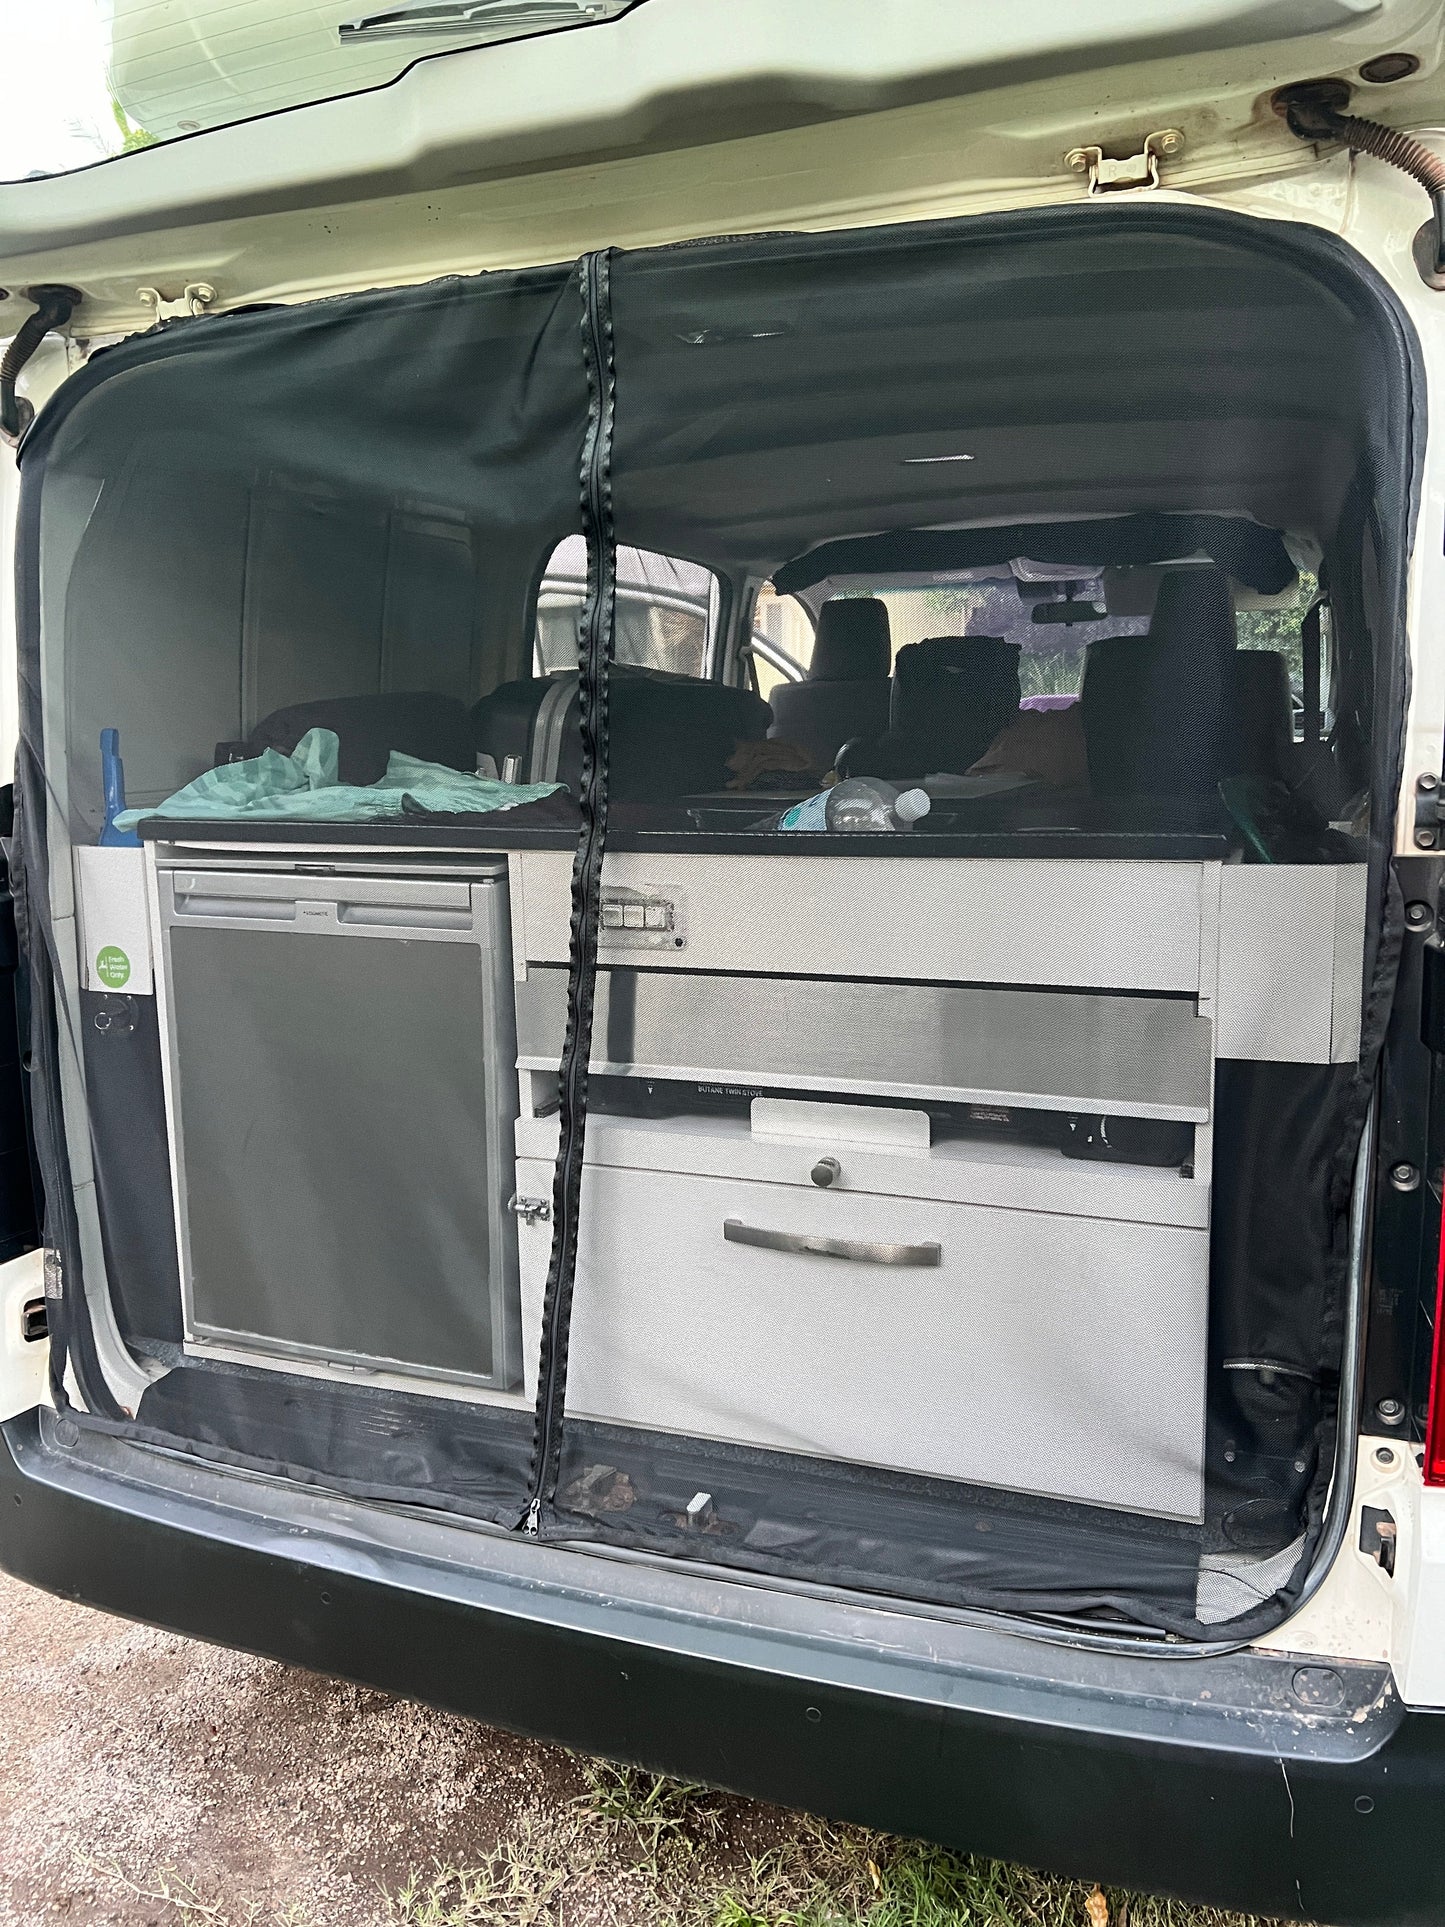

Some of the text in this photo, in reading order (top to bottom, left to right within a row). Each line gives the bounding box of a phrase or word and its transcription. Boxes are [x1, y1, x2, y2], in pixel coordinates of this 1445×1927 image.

[697, 1085, 763, 1097] BUTANE TWIN STOVE
